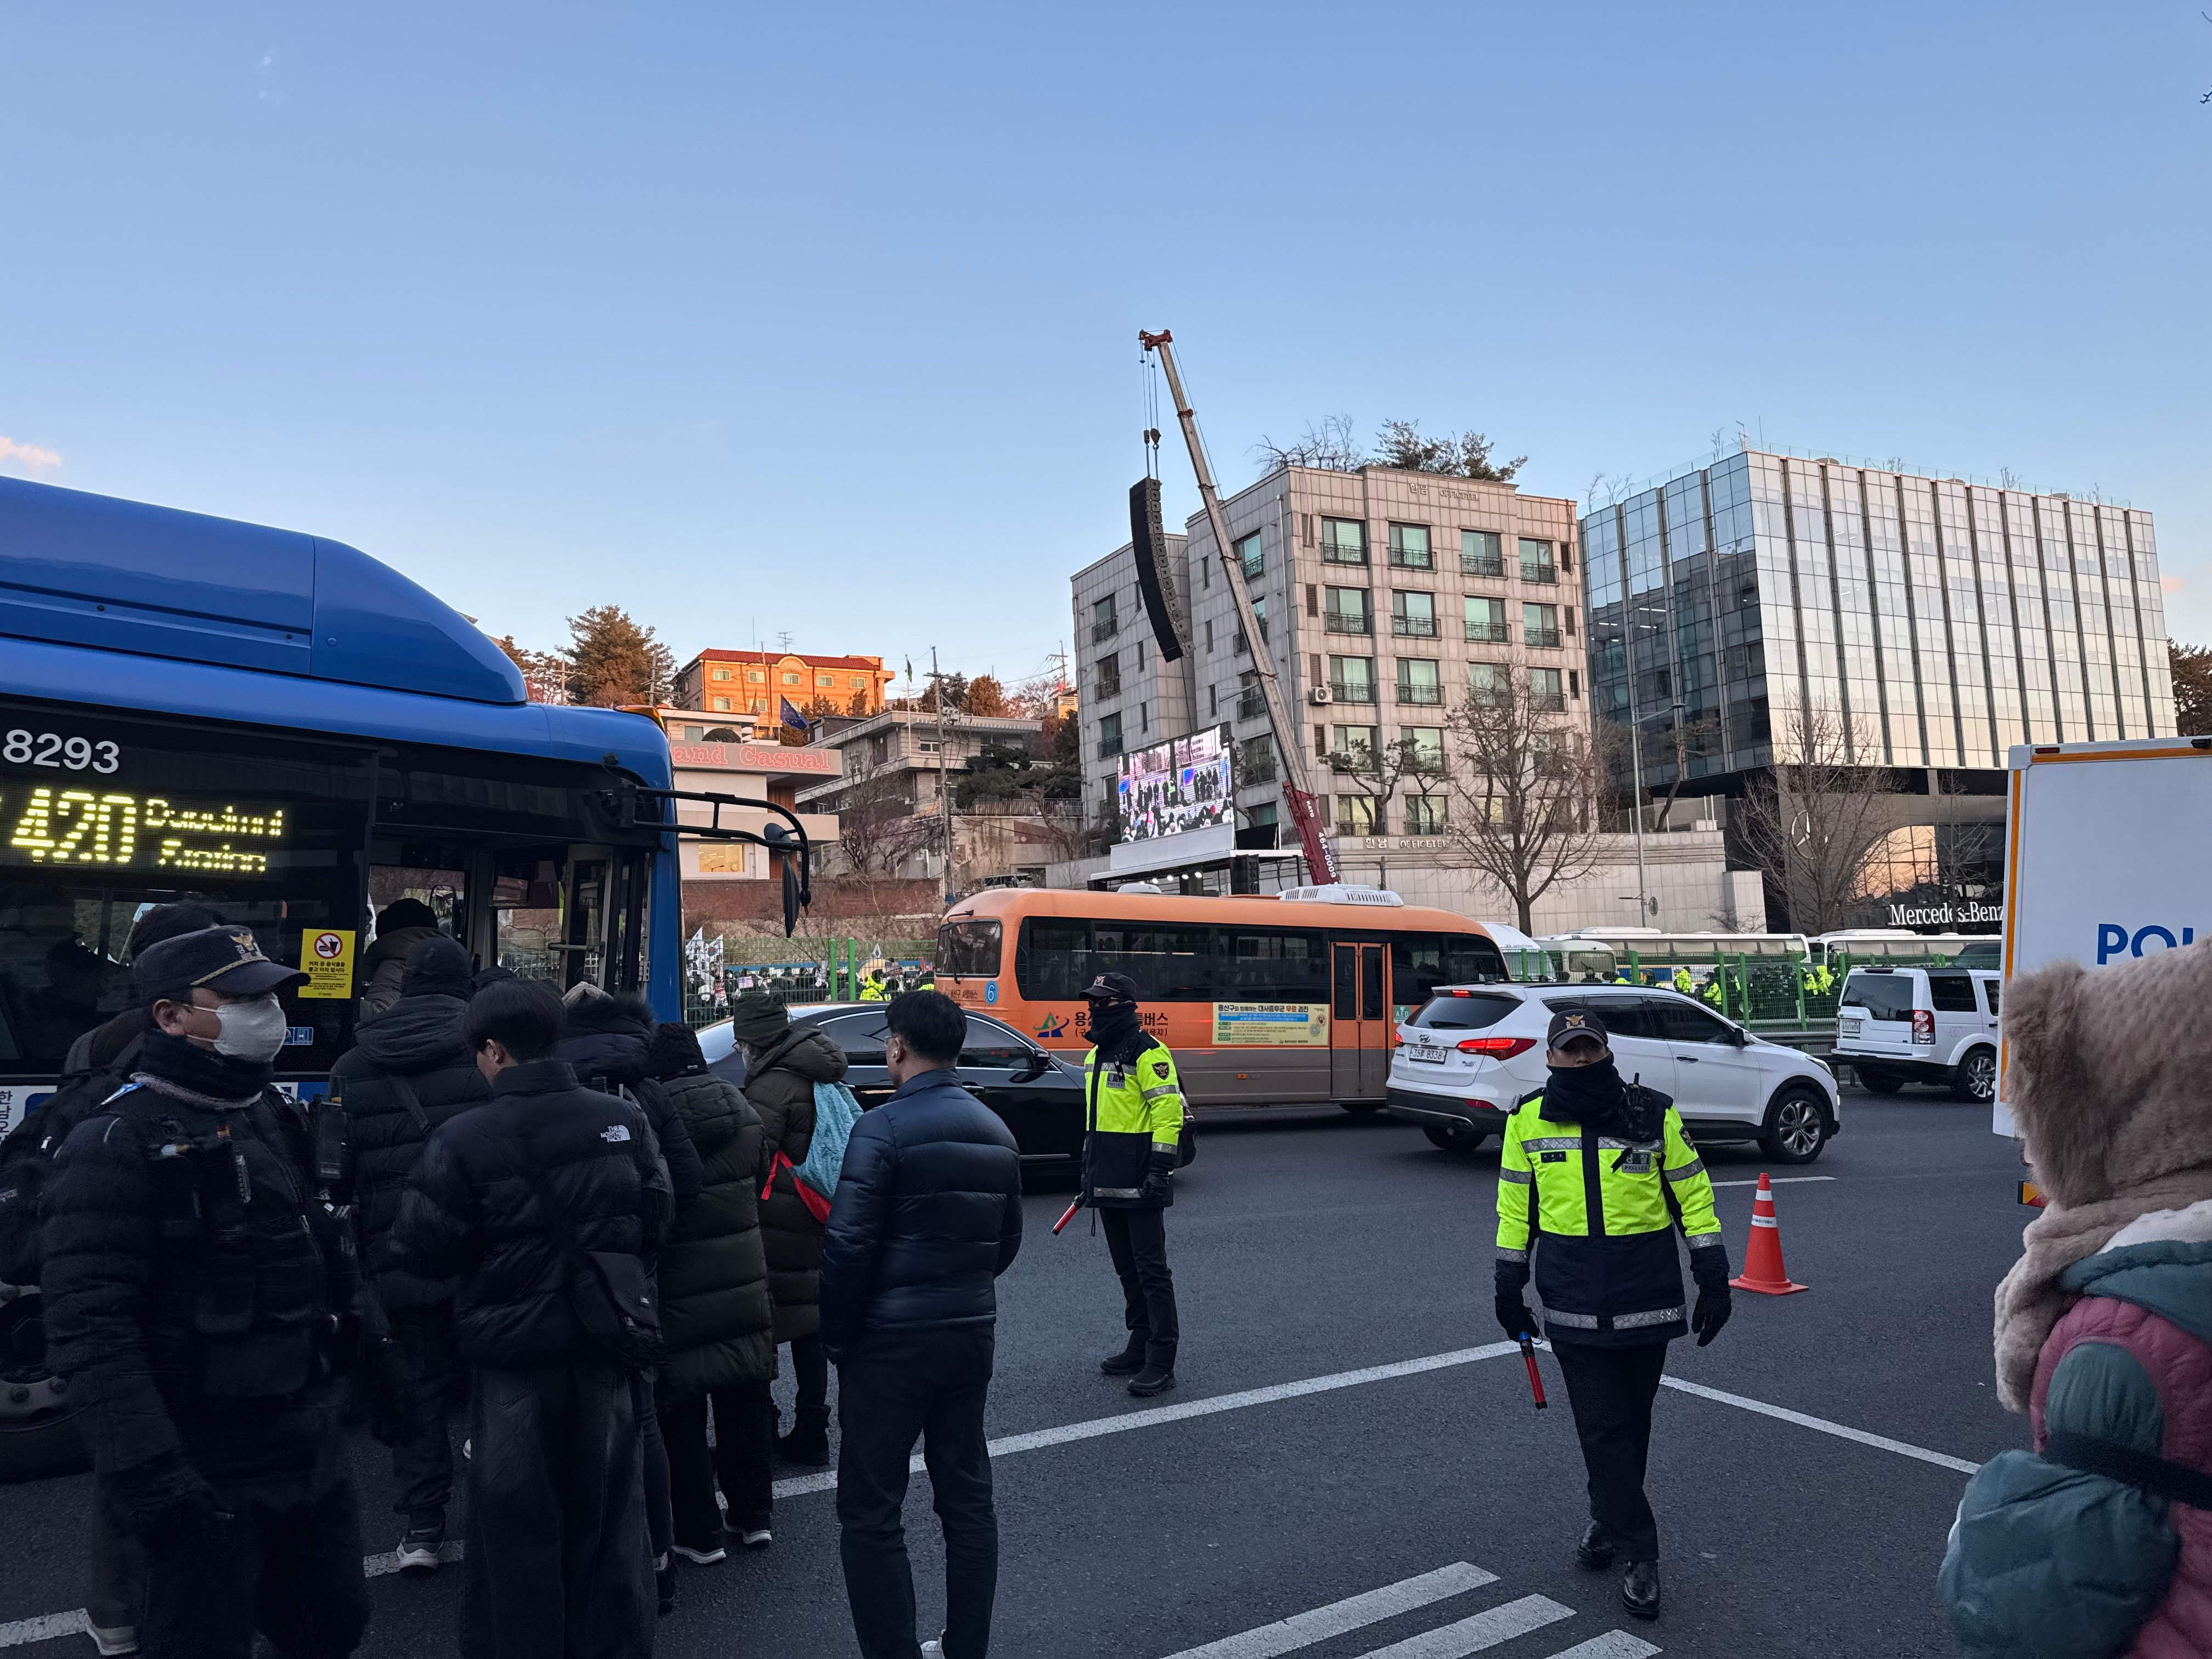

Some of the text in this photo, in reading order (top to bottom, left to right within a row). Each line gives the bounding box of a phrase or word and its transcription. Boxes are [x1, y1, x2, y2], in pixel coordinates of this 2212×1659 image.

[1440, 489, 1480, 501] OFFICETEL
[3, 729, 120, 774] 8293
[673, 745, 831, 770] and Casual
[1306, 800, 1314, 818] KATO
[11, 788, 135, 863] 420
[1365, 837, 1387, 849] 한남
[1318, 832, 1336, 878] 464-0009
[988, 984, 995, 1002] 6
